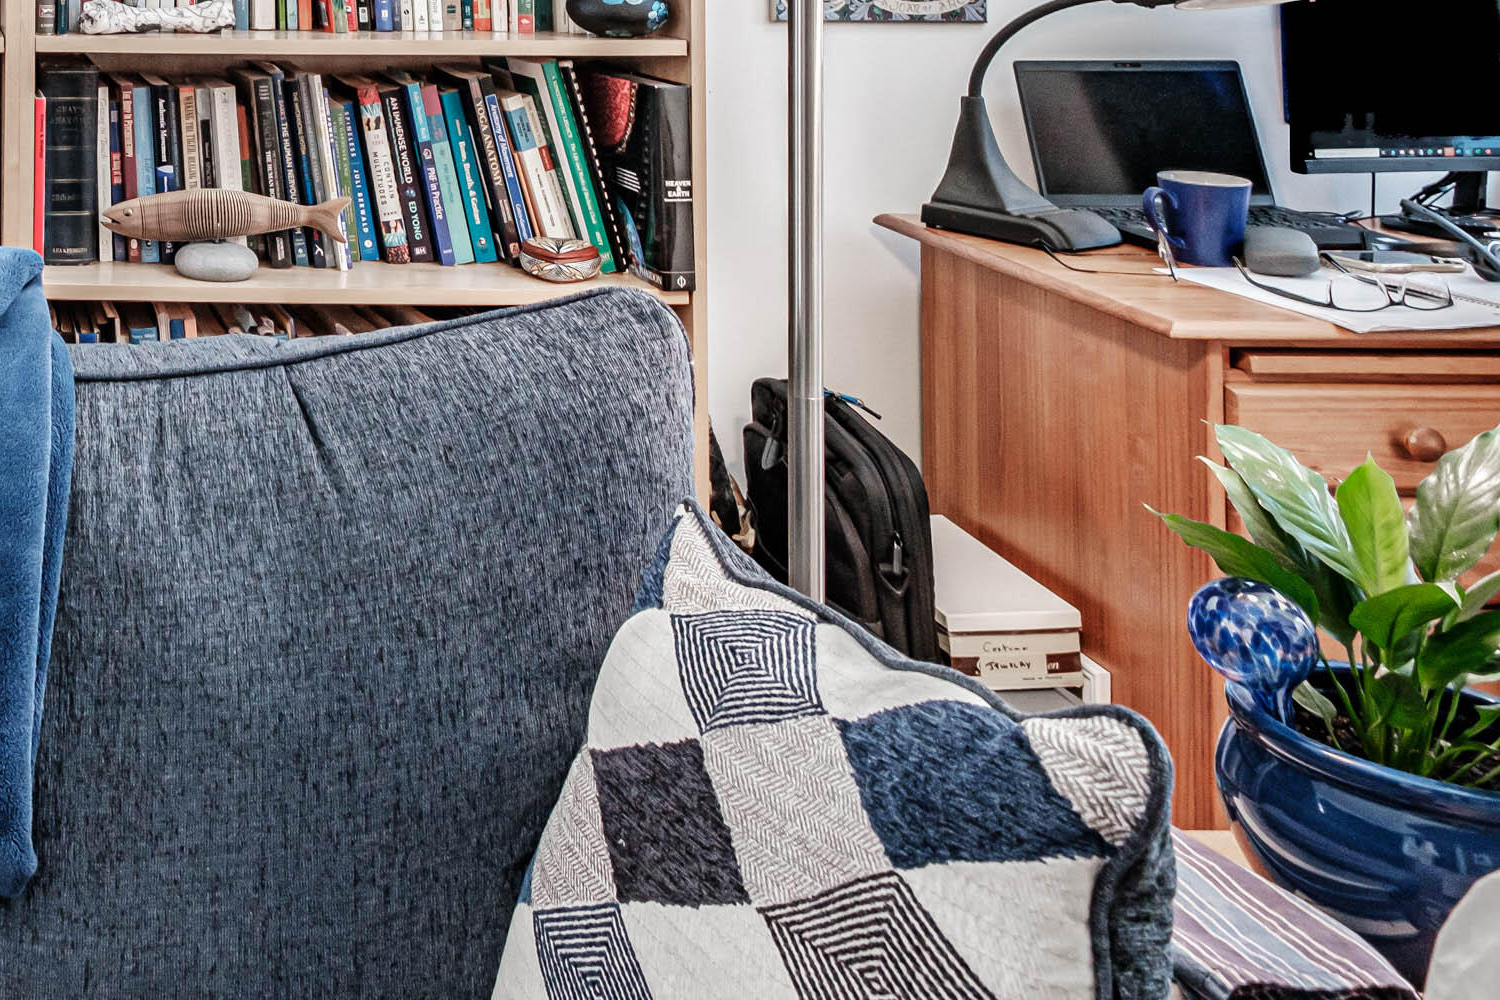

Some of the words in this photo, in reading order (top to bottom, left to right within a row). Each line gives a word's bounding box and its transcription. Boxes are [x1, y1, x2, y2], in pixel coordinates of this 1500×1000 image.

[389, 97, 399, 109] AN
[391, 110, 405, 151] IMMENSE
[372, 151, 387, 206] MULTITUDES
[384, 161, 395, 199] CONTAIN
[400, 152, 413, 184] WORLD
[408, 201, 417, 213] ED
[410, 213, 422, 241] YONG
